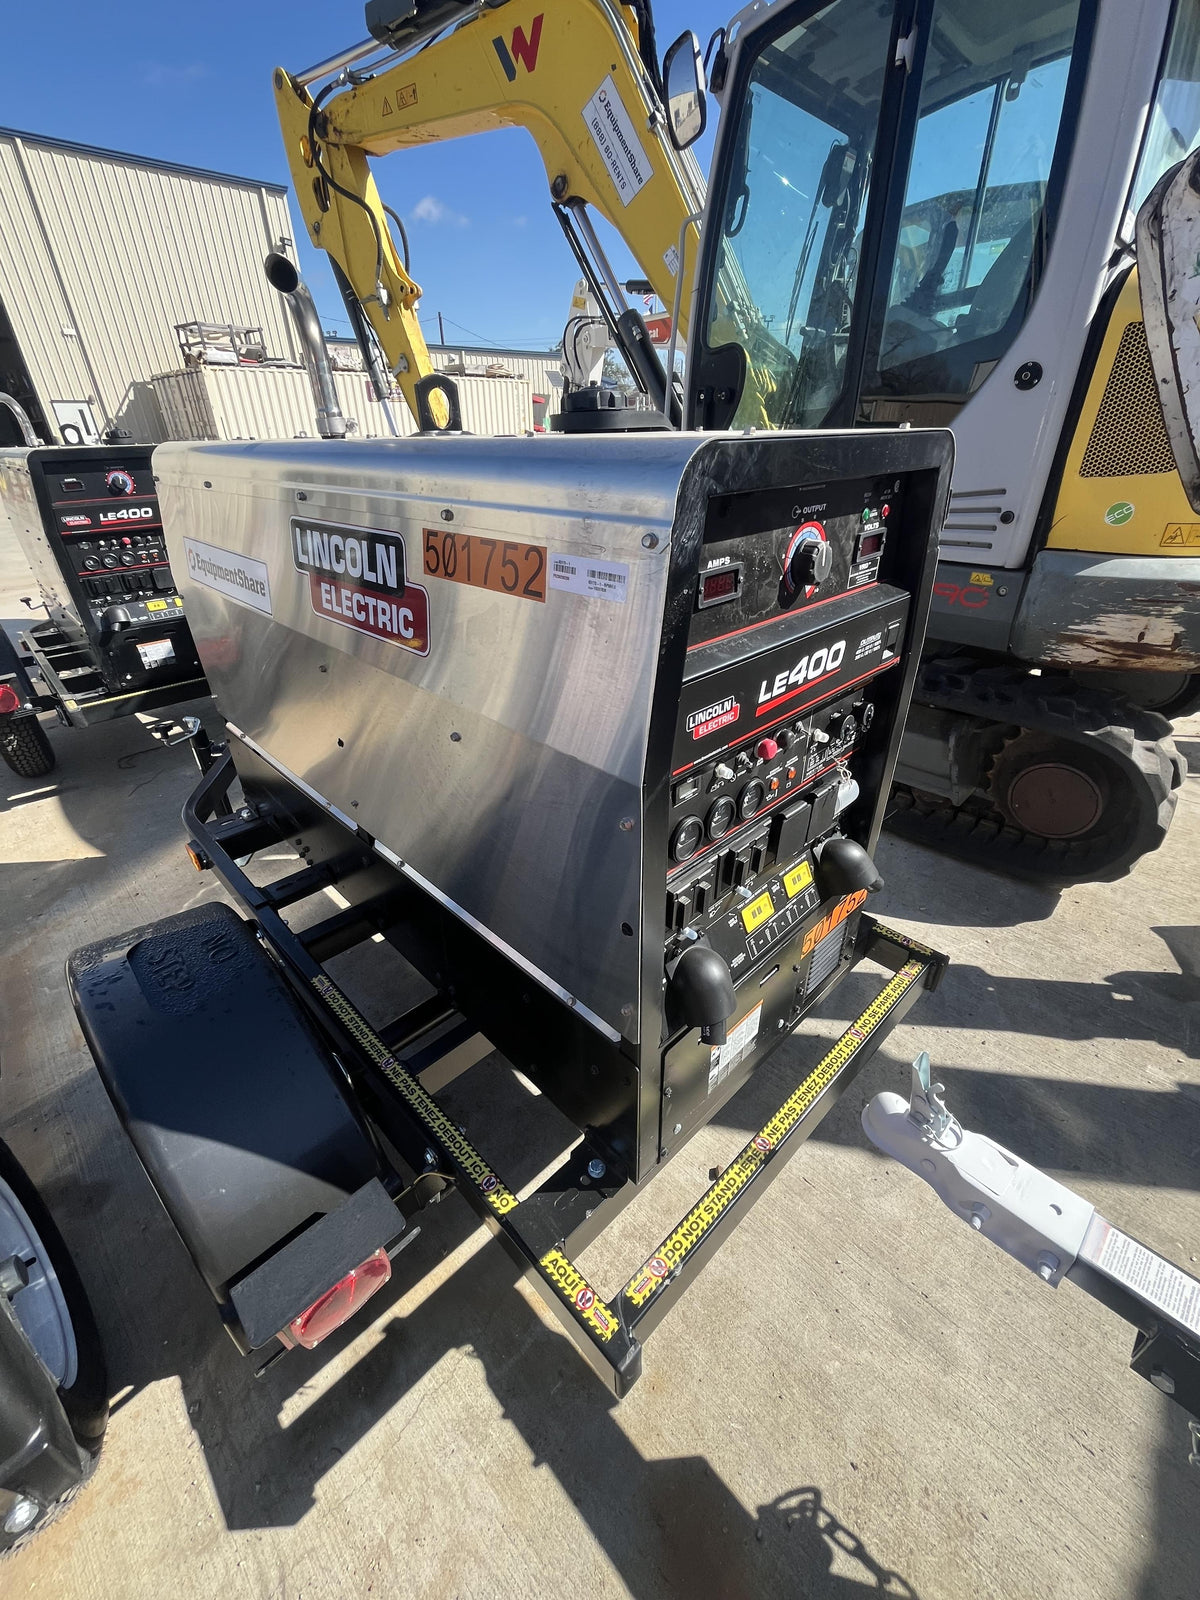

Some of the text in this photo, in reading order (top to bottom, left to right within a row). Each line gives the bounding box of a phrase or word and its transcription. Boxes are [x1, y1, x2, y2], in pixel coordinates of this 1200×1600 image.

[591, 117, 606, 146] (888)
[603, 100, 644, 185] EquipmentShare
[100, 508, 152, 521] LE400
[803, 504, 827, 514] OUTPUT
[1106, 504, 1134, 523] ECO
[195, 552, 266, 597] EquipmentShare
[295, 527, 397, 588] LINCOLN
[426, 530, 546, 598] 501752
[707, 556, 730, 570] AMPS
[320, 580, 414, 640] ELECTRIC
[758, 640, 847, 704] LE400
[690, 700, 732, 728] LINCOLN
[699, 712, 736, 735] ELECTRIC
[328, 994, 386, 1060] DO NOT STAND HERE
[860, 1018, 872, 1032] NO
[868, 1007, 880, 1020] SE
[876, 991, 894, 1012] PARE
[767, 1037, 856, 1140] NE PAS TENEZ DEBOUT ICI
[390, 1066, 486, 1178] NE PAS TENEZ DEBOUT ICI
[494, 1189, 510, 1208] NO
[664, 1150, 762, 1262] DO NOT STAND HERE
